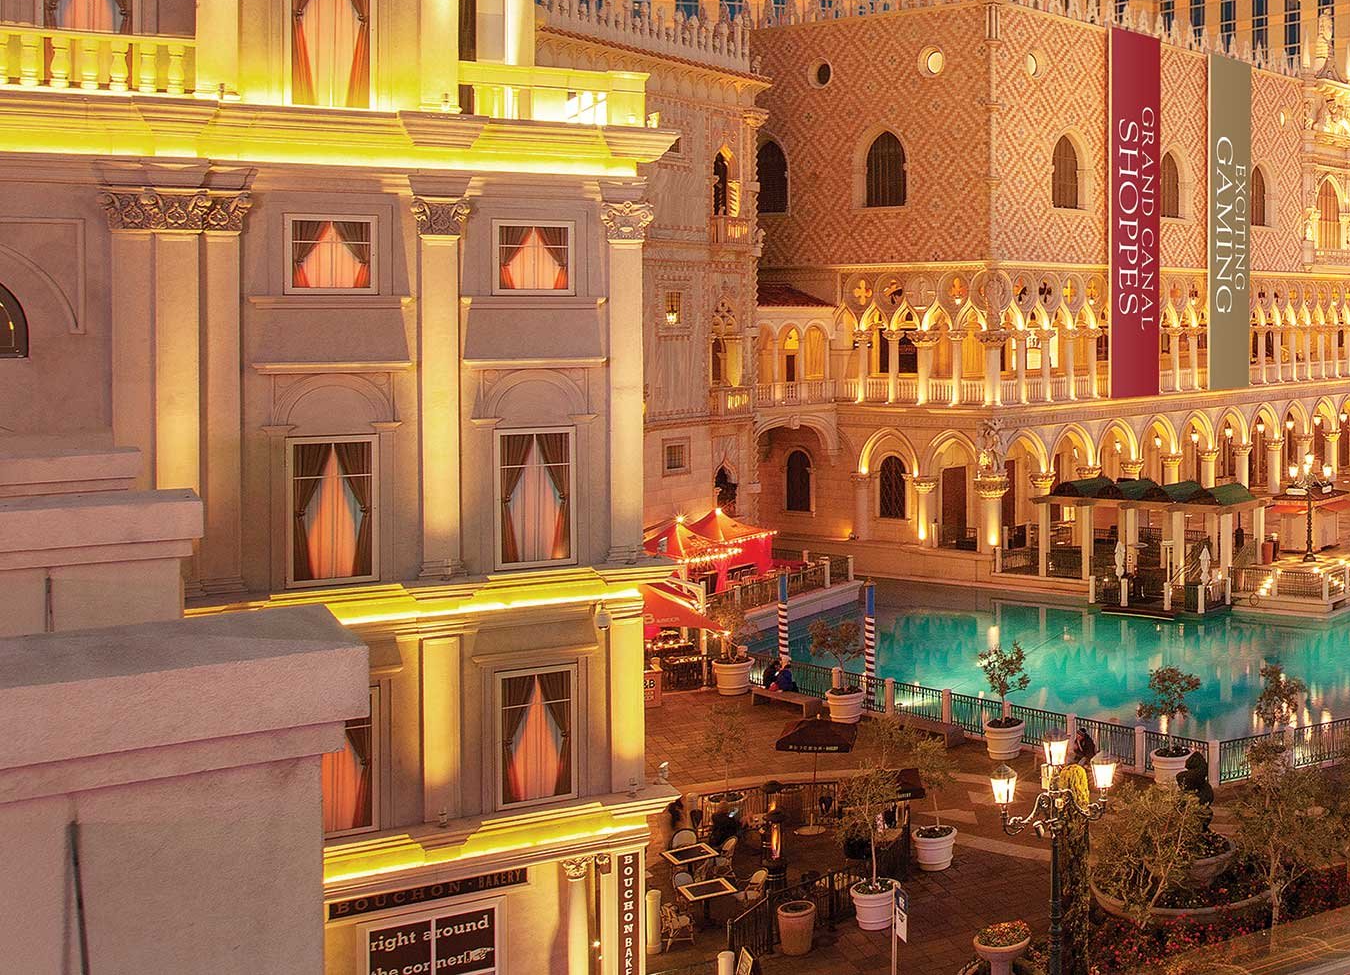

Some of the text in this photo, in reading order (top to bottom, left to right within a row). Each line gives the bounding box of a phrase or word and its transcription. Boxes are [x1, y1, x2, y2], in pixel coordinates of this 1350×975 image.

[1117, 117, 1140, 316] SHOPPES
[1140, 106, 1155, 331] GRAND CANAL
[1215, 135, 1234, 314] GAMING
[1233, 164, 1246, 292] EXCITING
[334, 869, 523, 915] BOUCHON BAKERY
[369, 914, 490, 953] right around
[623, 855, 634, 934] BOUCHON
[402, 954, 465, 975] corner
